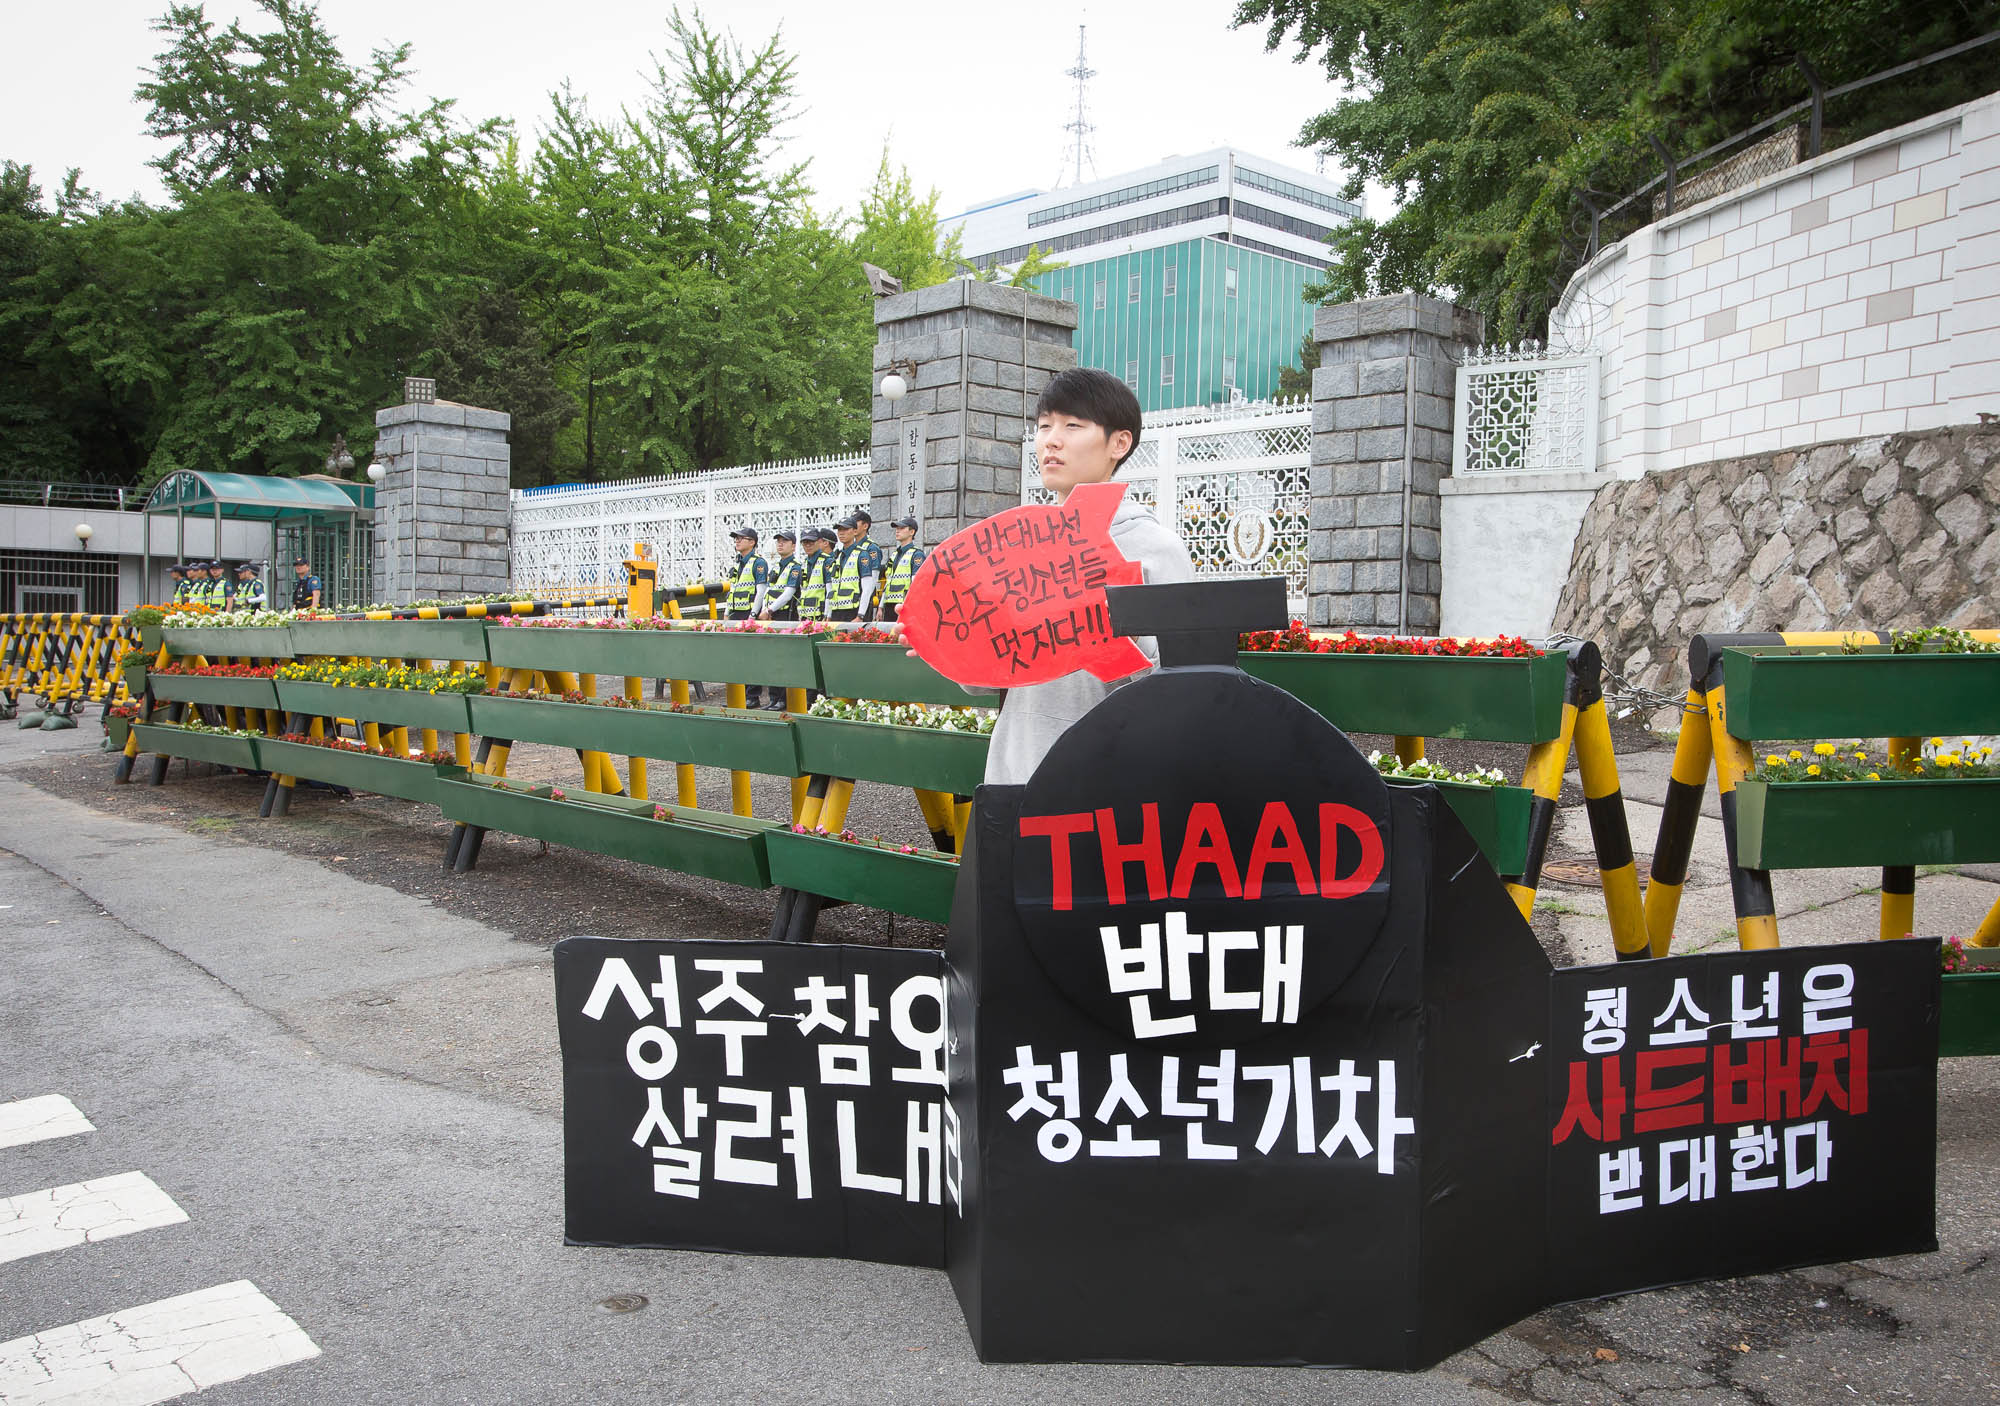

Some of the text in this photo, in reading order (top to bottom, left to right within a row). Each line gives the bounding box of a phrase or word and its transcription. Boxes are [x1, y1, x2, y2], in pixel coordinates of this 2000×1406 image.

[933, 548, 1108, 641] 성주 청소년들
[990, 604, 1108, 674] 멋지다!!
[1019, 801, 1385, 910] THAAD
[582, 955, 768, 1081] 성주
[1100, 912, 1304, 1039] 반대
[1582, 963, 1855, 1054] 청소년은
[1002, 1045, 1416, 1175] 청소년기차
[1599, 1120, 1833, 1215] 반대한다
